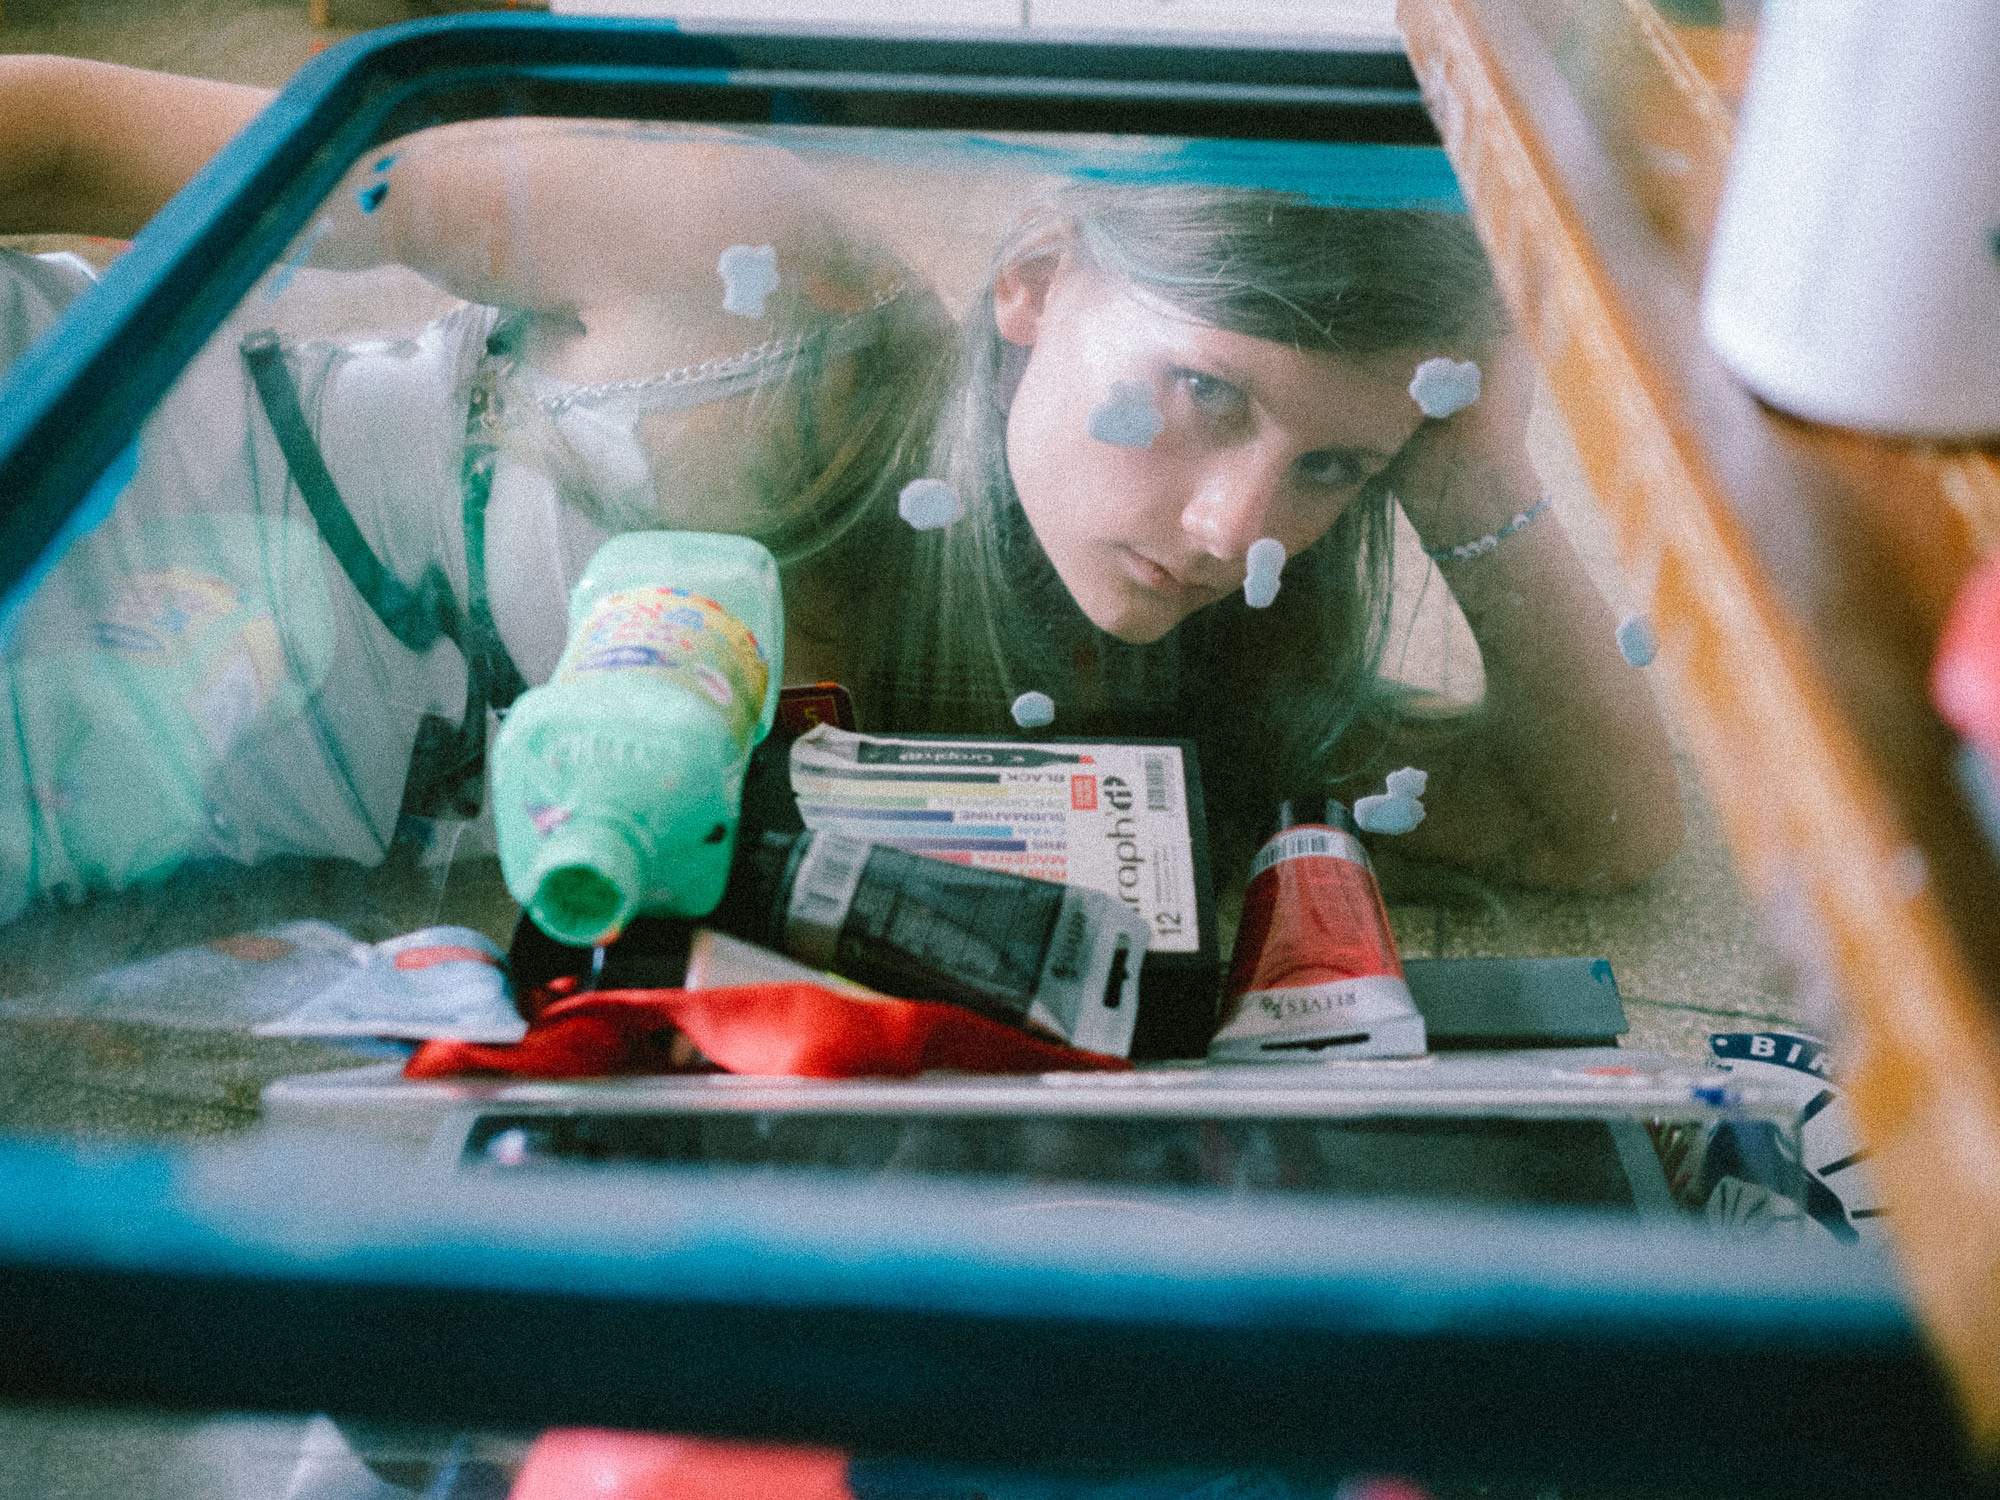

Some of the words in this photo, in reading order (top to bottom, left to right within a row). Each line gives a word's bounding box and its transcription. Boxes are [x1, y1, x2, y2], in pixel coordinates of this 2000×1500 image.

[1006, 772, 1066, 784] BLACK
[960, 810, 1066, 823] SUBMARINE
[977, 854, 1067, 866] MAGENTA
[1157, 912, 1182, 938] 12
